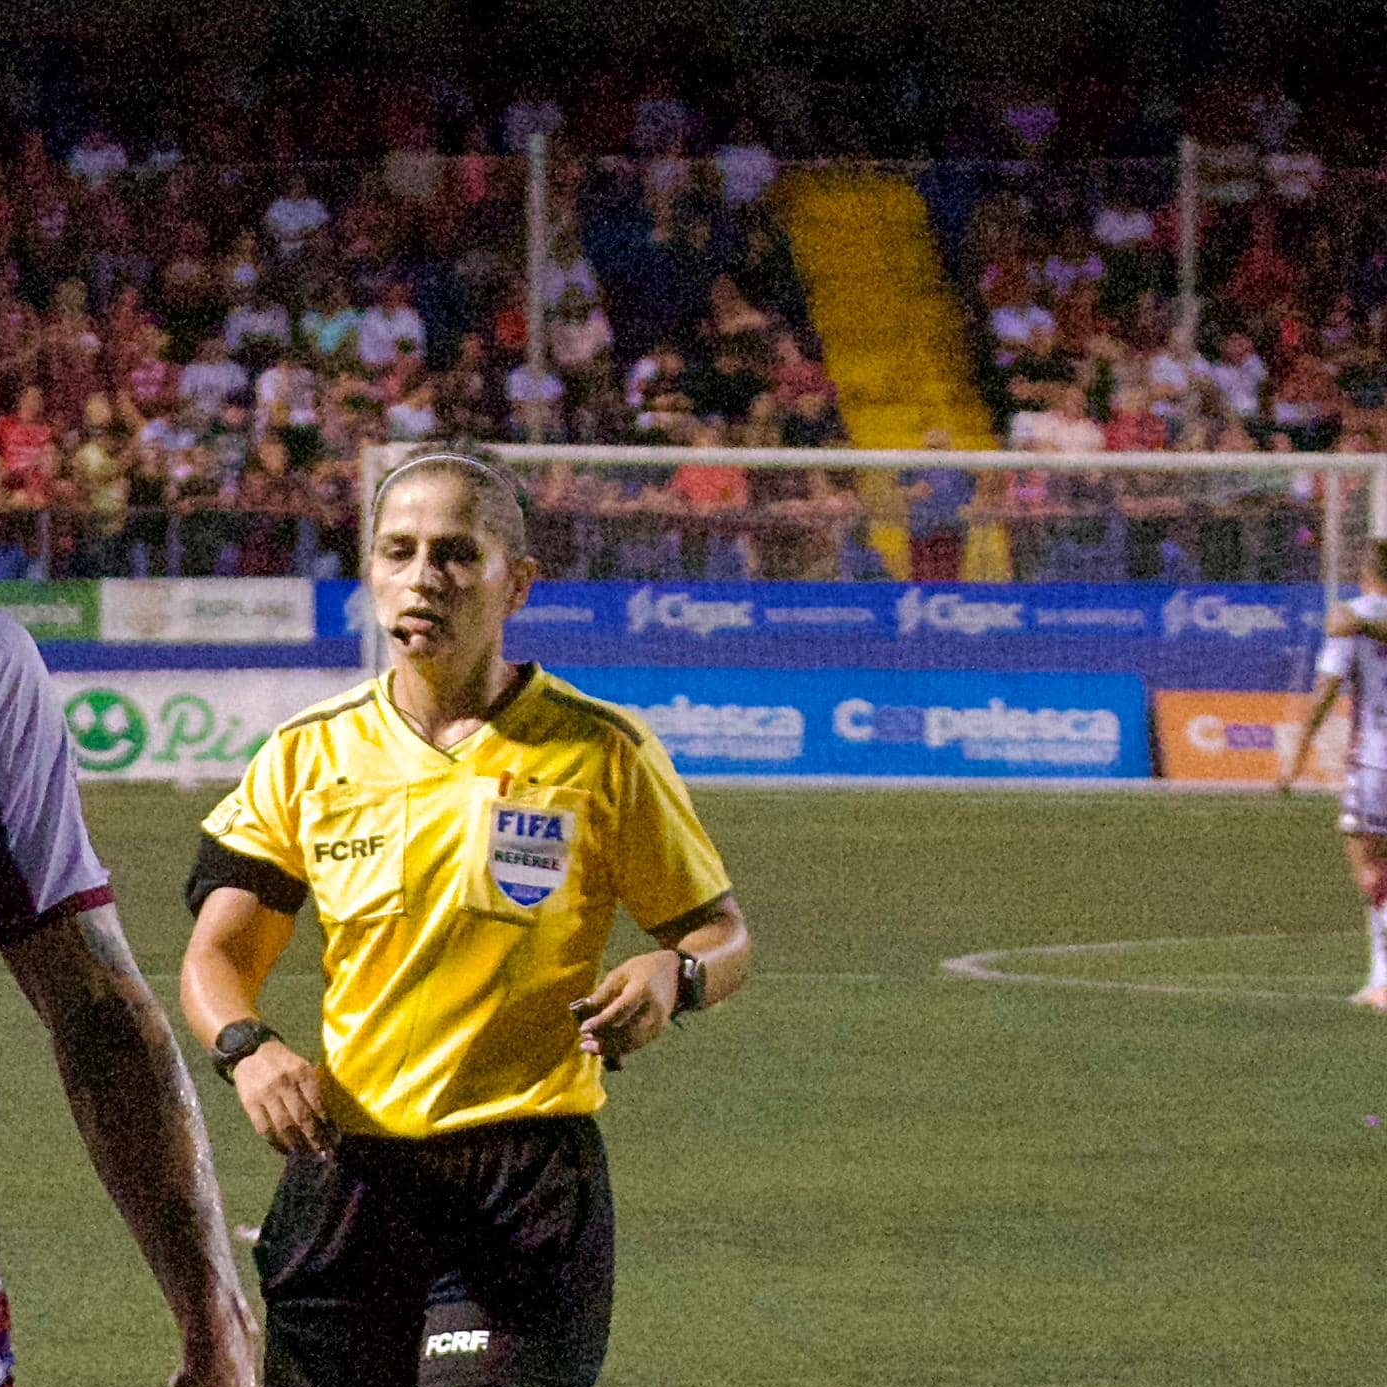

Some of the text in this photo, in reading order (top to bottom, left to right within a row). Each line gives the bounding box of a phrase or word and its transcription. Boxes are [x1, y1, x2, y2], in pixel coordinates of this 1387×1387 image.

[497, 810, 564, 842] FIFA
[313, 835, 385, 863] FCRF
[494, 849, 561, 871] REFEREE
[426, 1330, 491, 1356] FCRF
